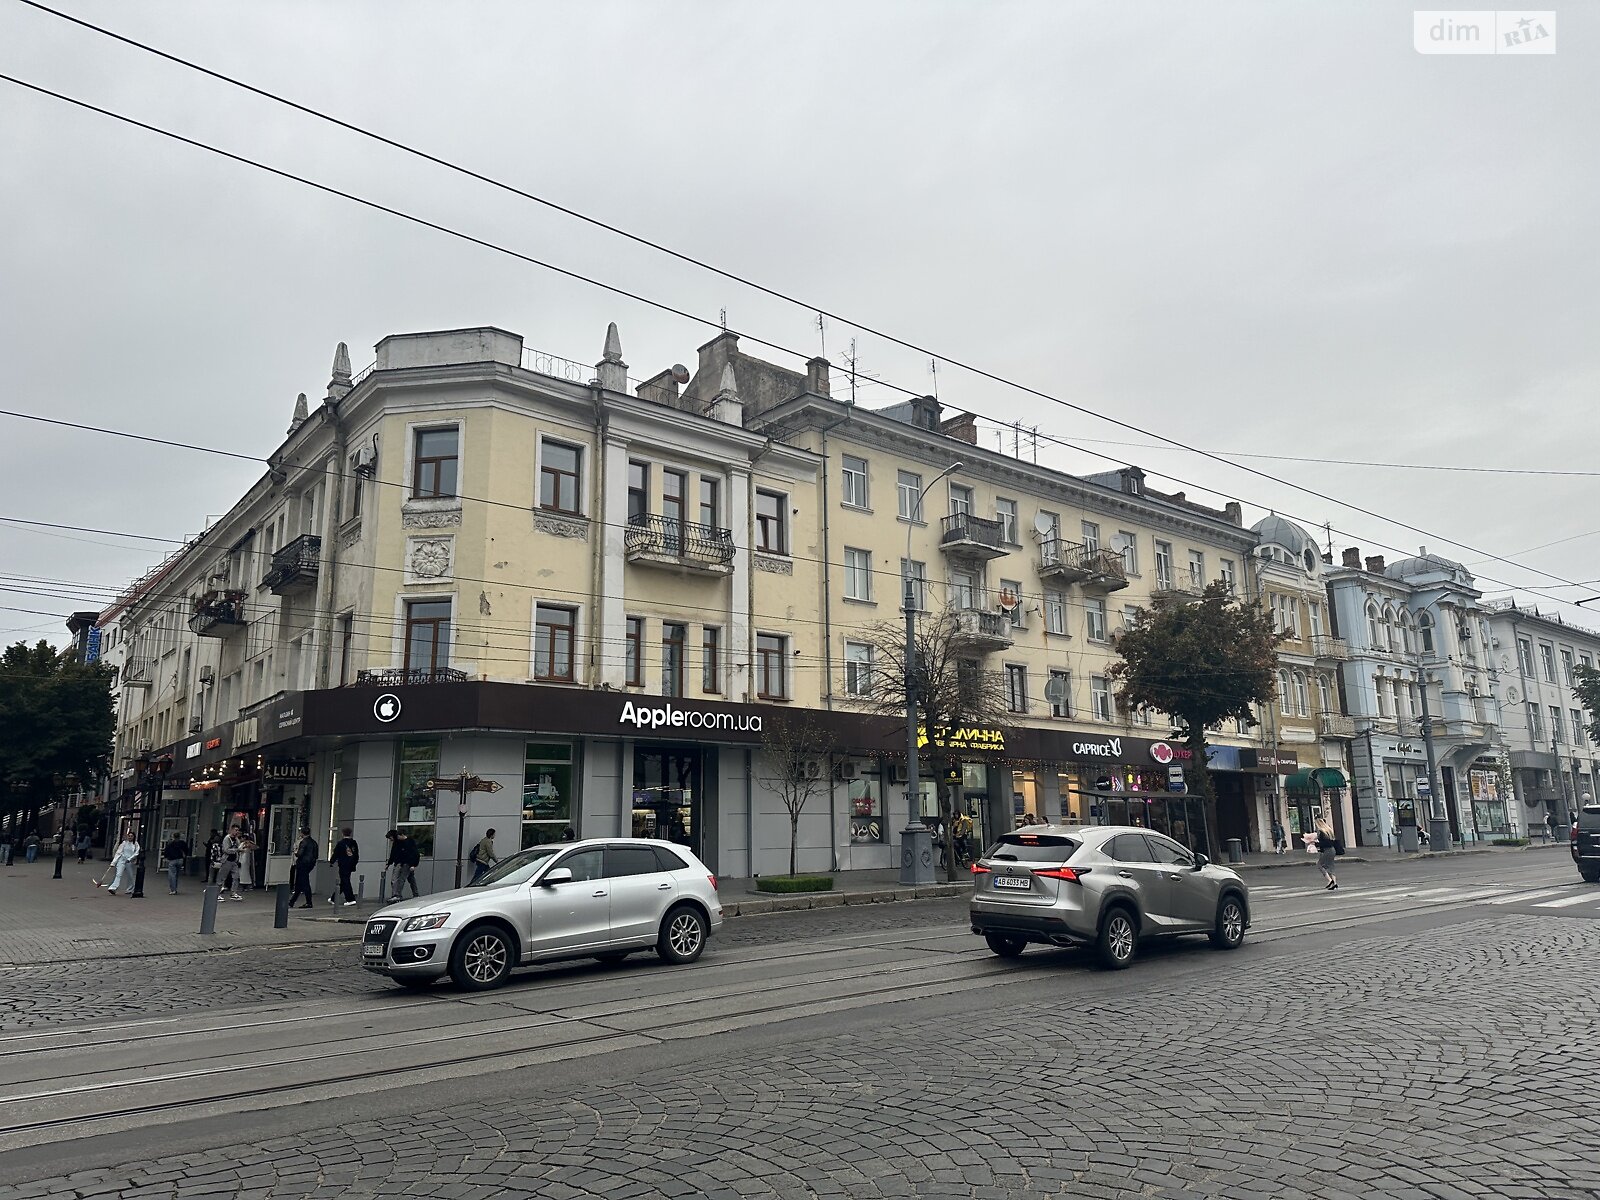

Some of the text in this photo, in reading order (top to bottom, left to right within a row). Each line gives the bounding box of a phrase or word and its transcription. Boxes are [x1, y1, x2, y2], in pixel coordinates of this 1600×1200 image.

[85, 625, 101, 665] БАНК
[619, 701, 762, 732] Appleroom.ua
[970, 742, 1005, 751] ФАБРИКА
[1072, 742, 1112, 757] CAPRICE
[1006, 878, 1019, 886] 6033
